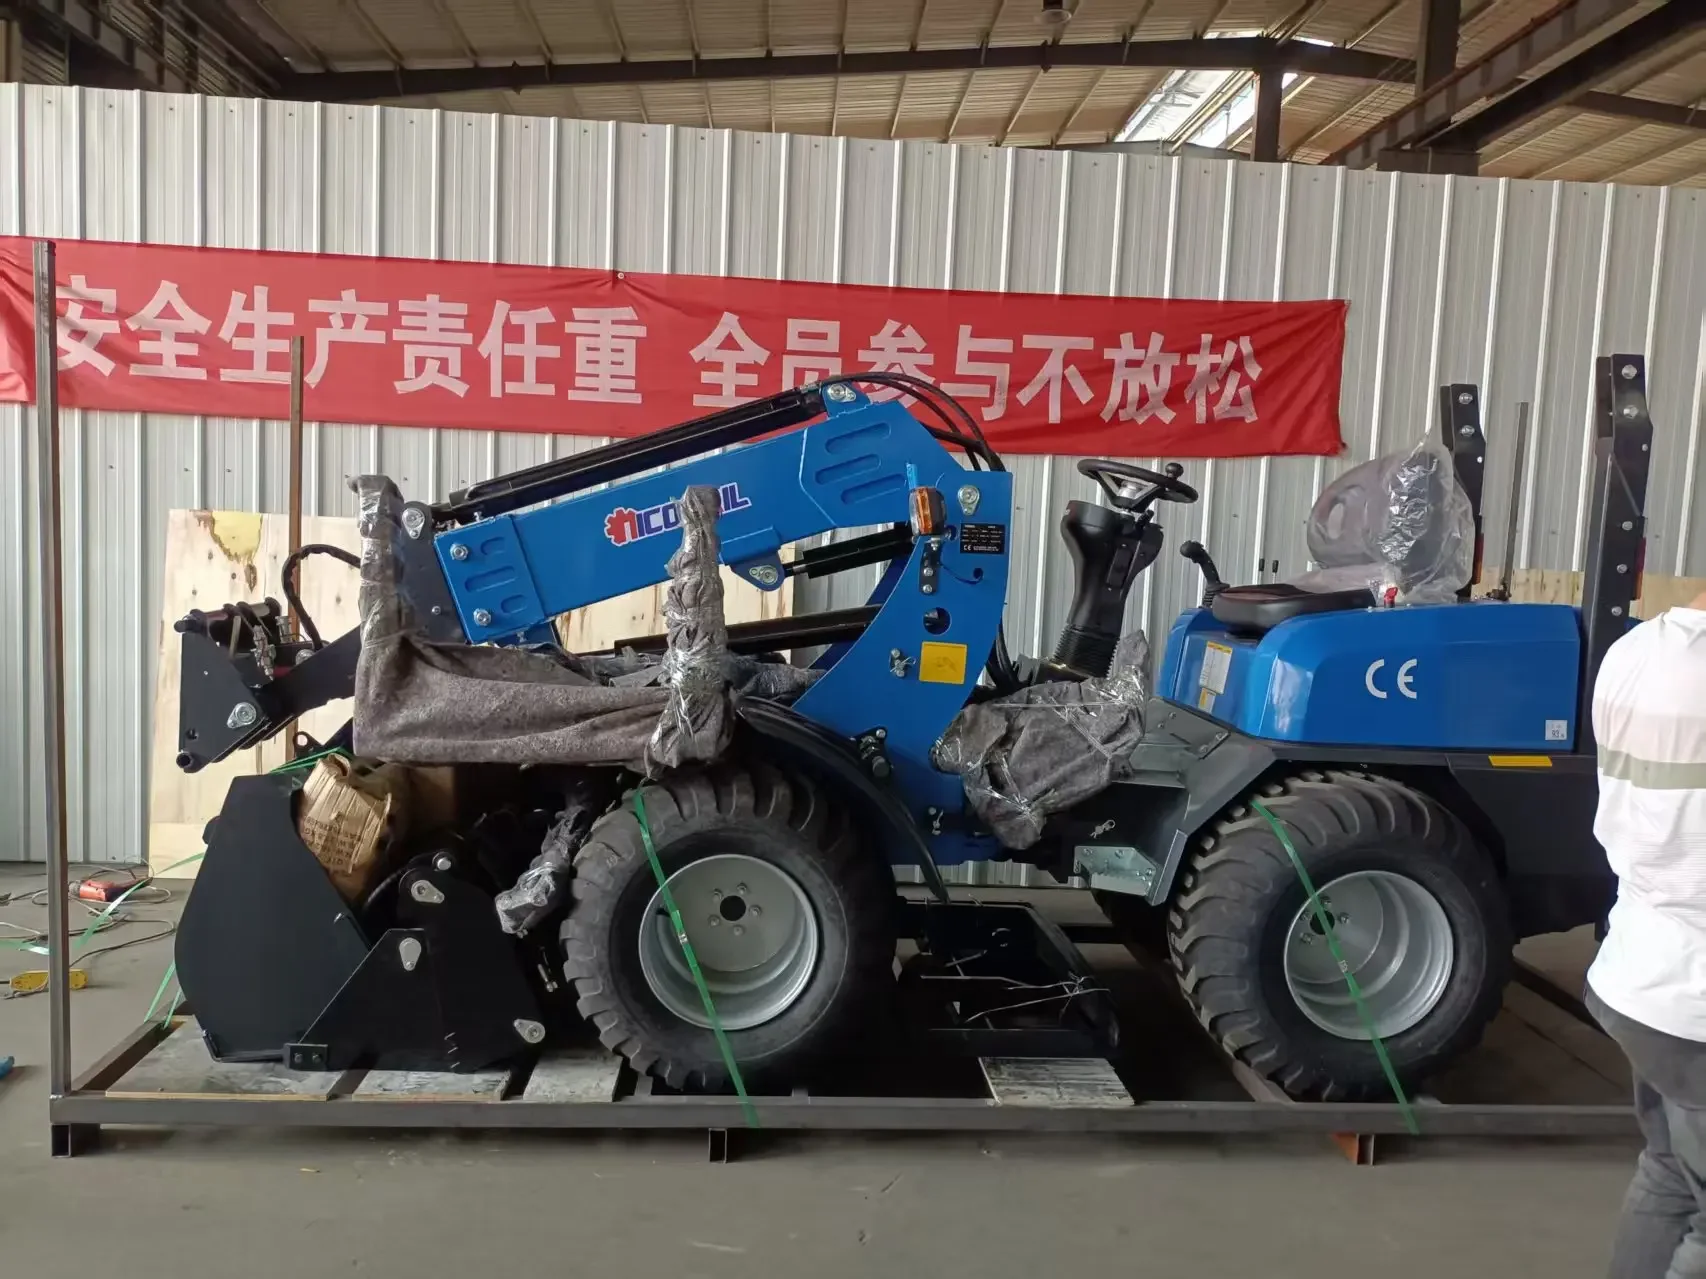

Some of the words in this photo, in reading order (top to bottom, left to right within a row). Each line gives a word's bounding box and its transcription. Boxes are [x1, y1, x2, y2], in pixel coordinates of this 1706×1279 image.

[56, 274, 647, 405] 安全生产责任重
[689, 311, 1262, 425] 全员参与不放松
[1365, 659, 1418, 699] CE
